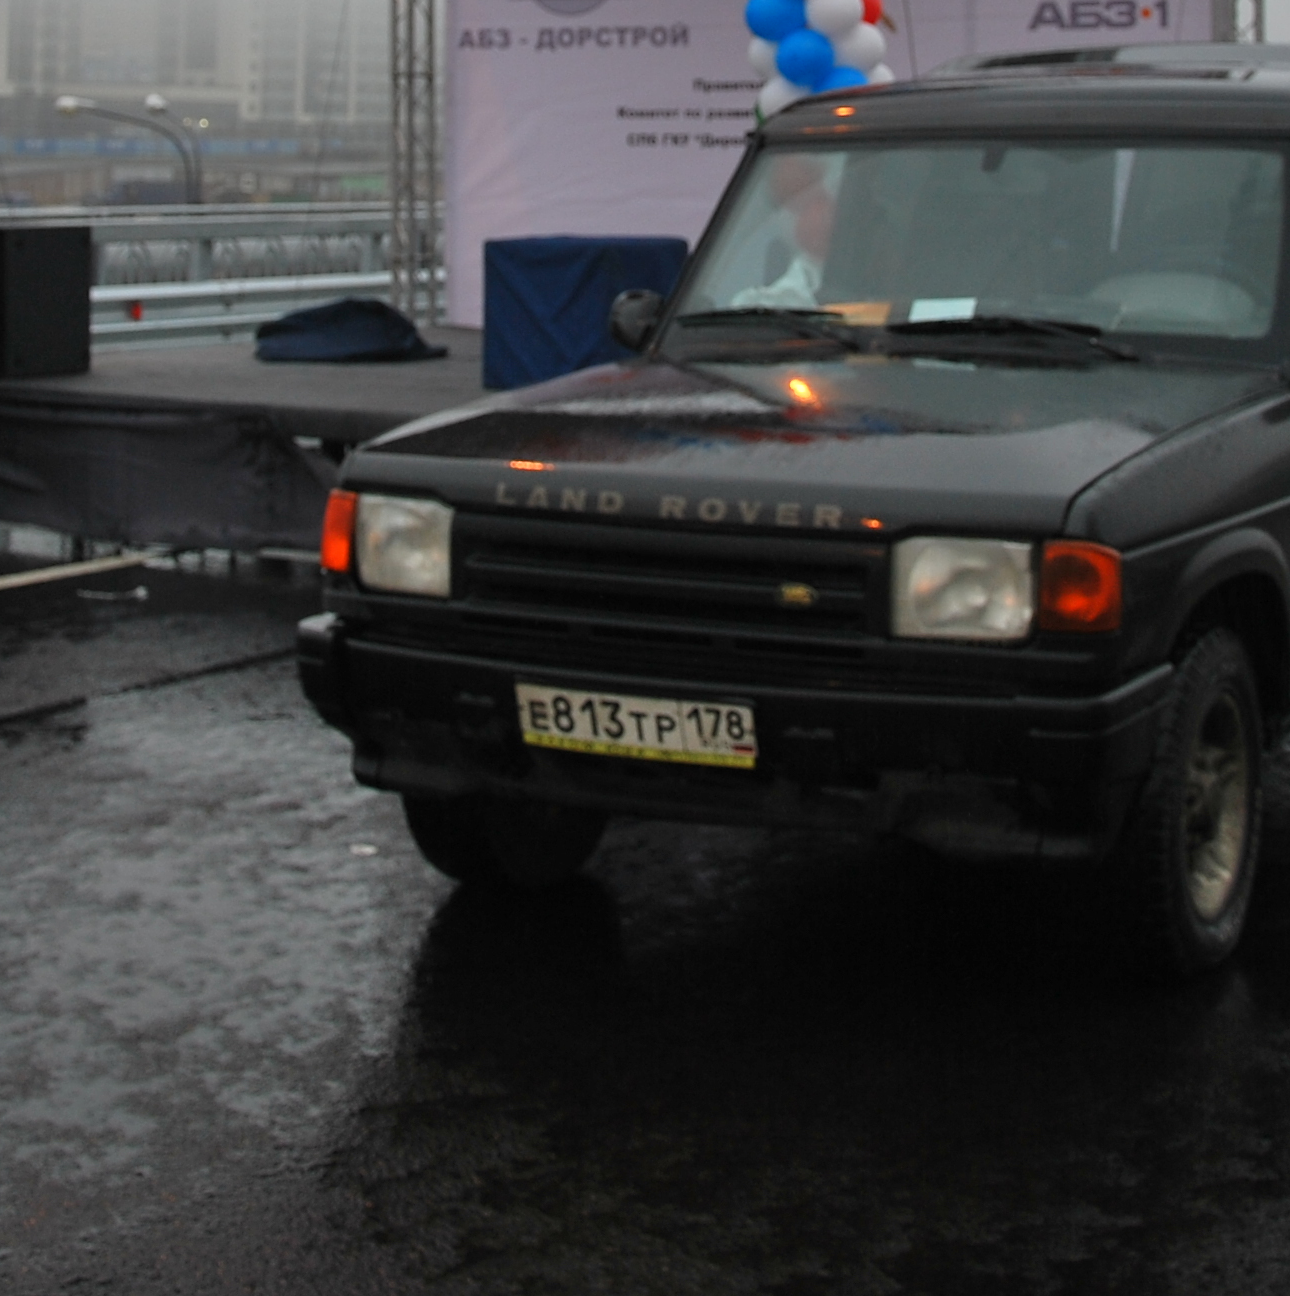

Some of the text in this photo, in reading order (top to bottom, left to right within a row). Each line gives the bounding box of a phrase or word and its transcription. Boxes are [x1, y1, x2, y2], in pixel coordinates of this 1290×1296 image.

[458, 26, 512, 50] АБЗ
[534, 21, 692, 52] ДОРСТРОЙ
[617, 106, 679, 119] Комитет
[683, 107, 702, 119] по
[494, 482, 844, 529] LAND ROVER
